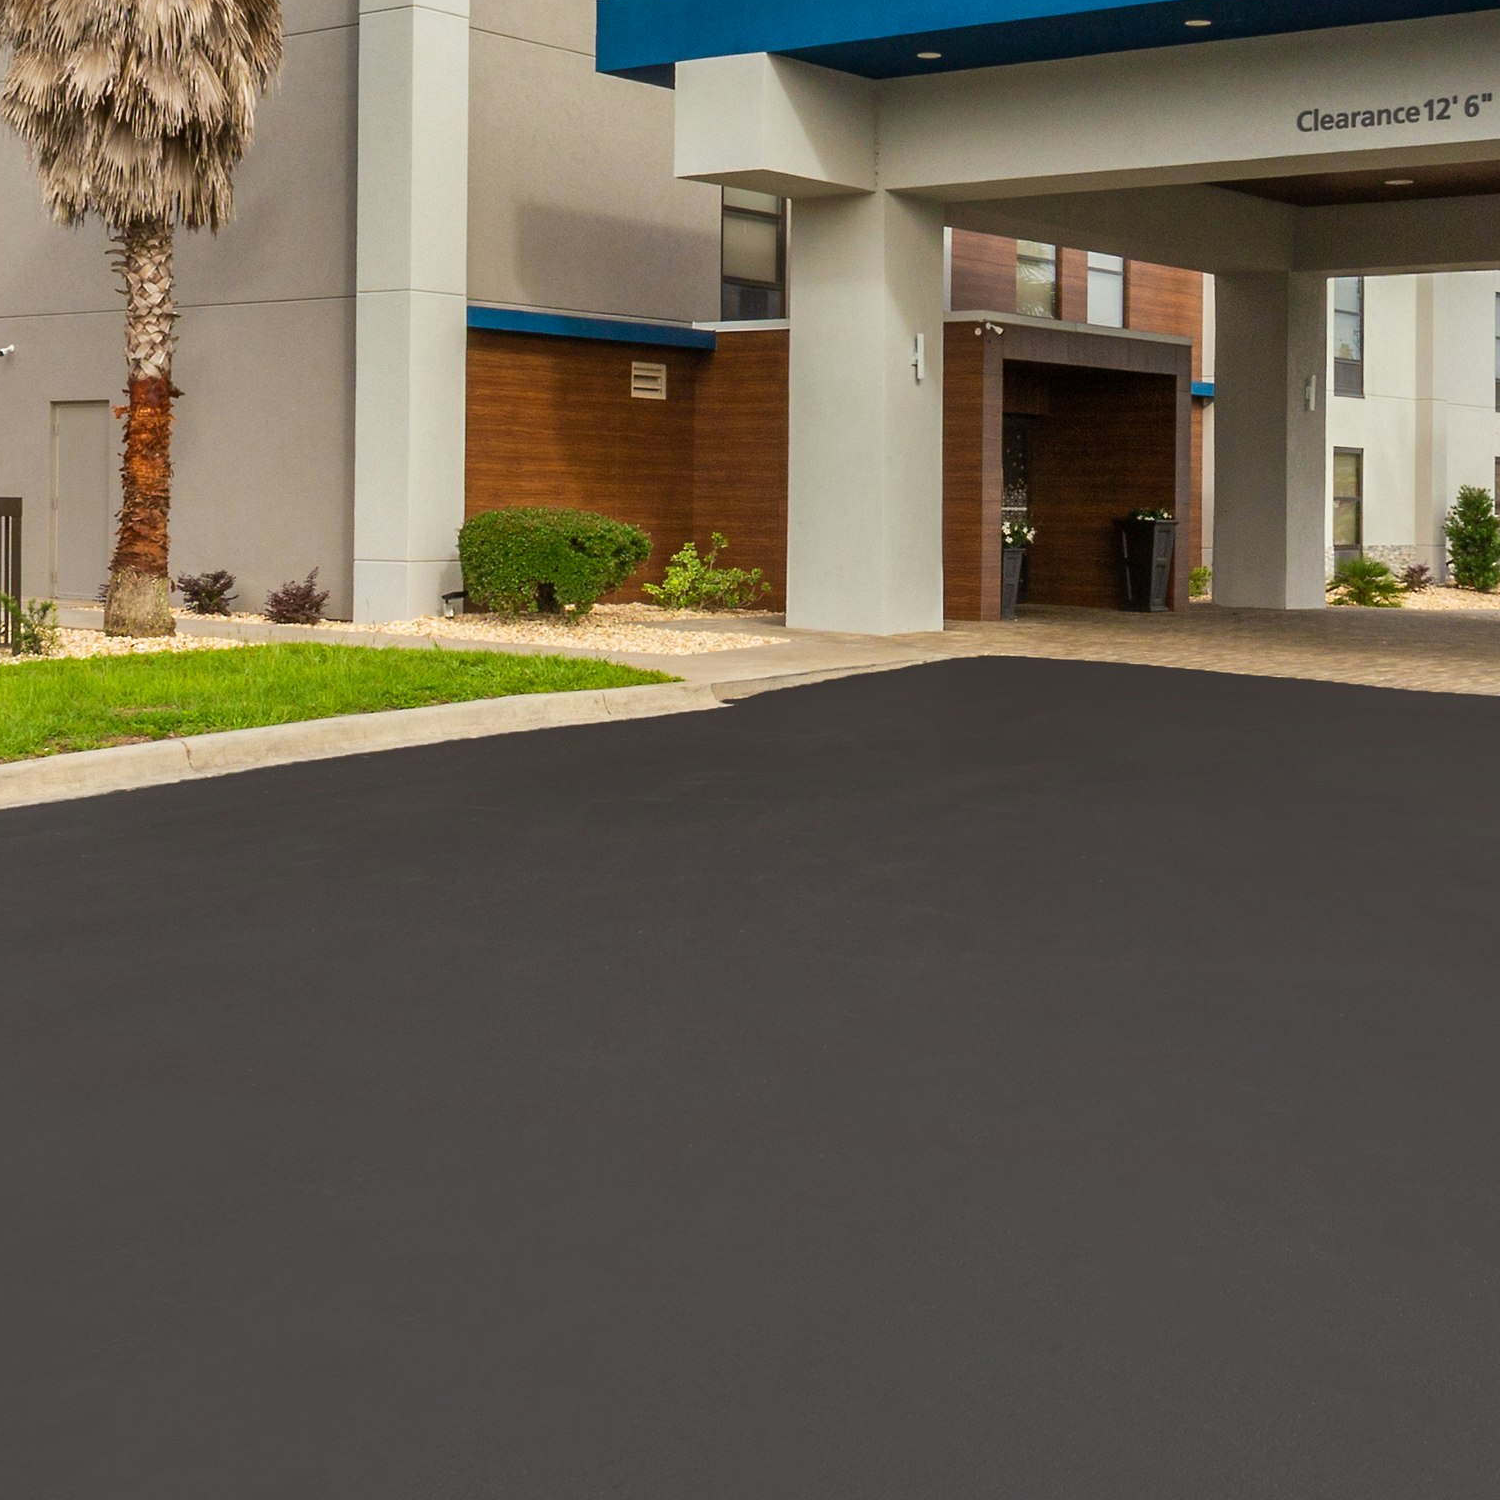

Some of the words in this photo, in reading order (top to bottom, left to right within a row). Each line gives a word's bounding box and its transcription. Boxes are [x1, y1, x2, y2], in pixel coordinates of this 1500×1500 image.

[1296, 106, 1421, 132] Clearance
[1423, 95, 1458, 121] 12'
[1464, 92, 1493, 117] 6"
